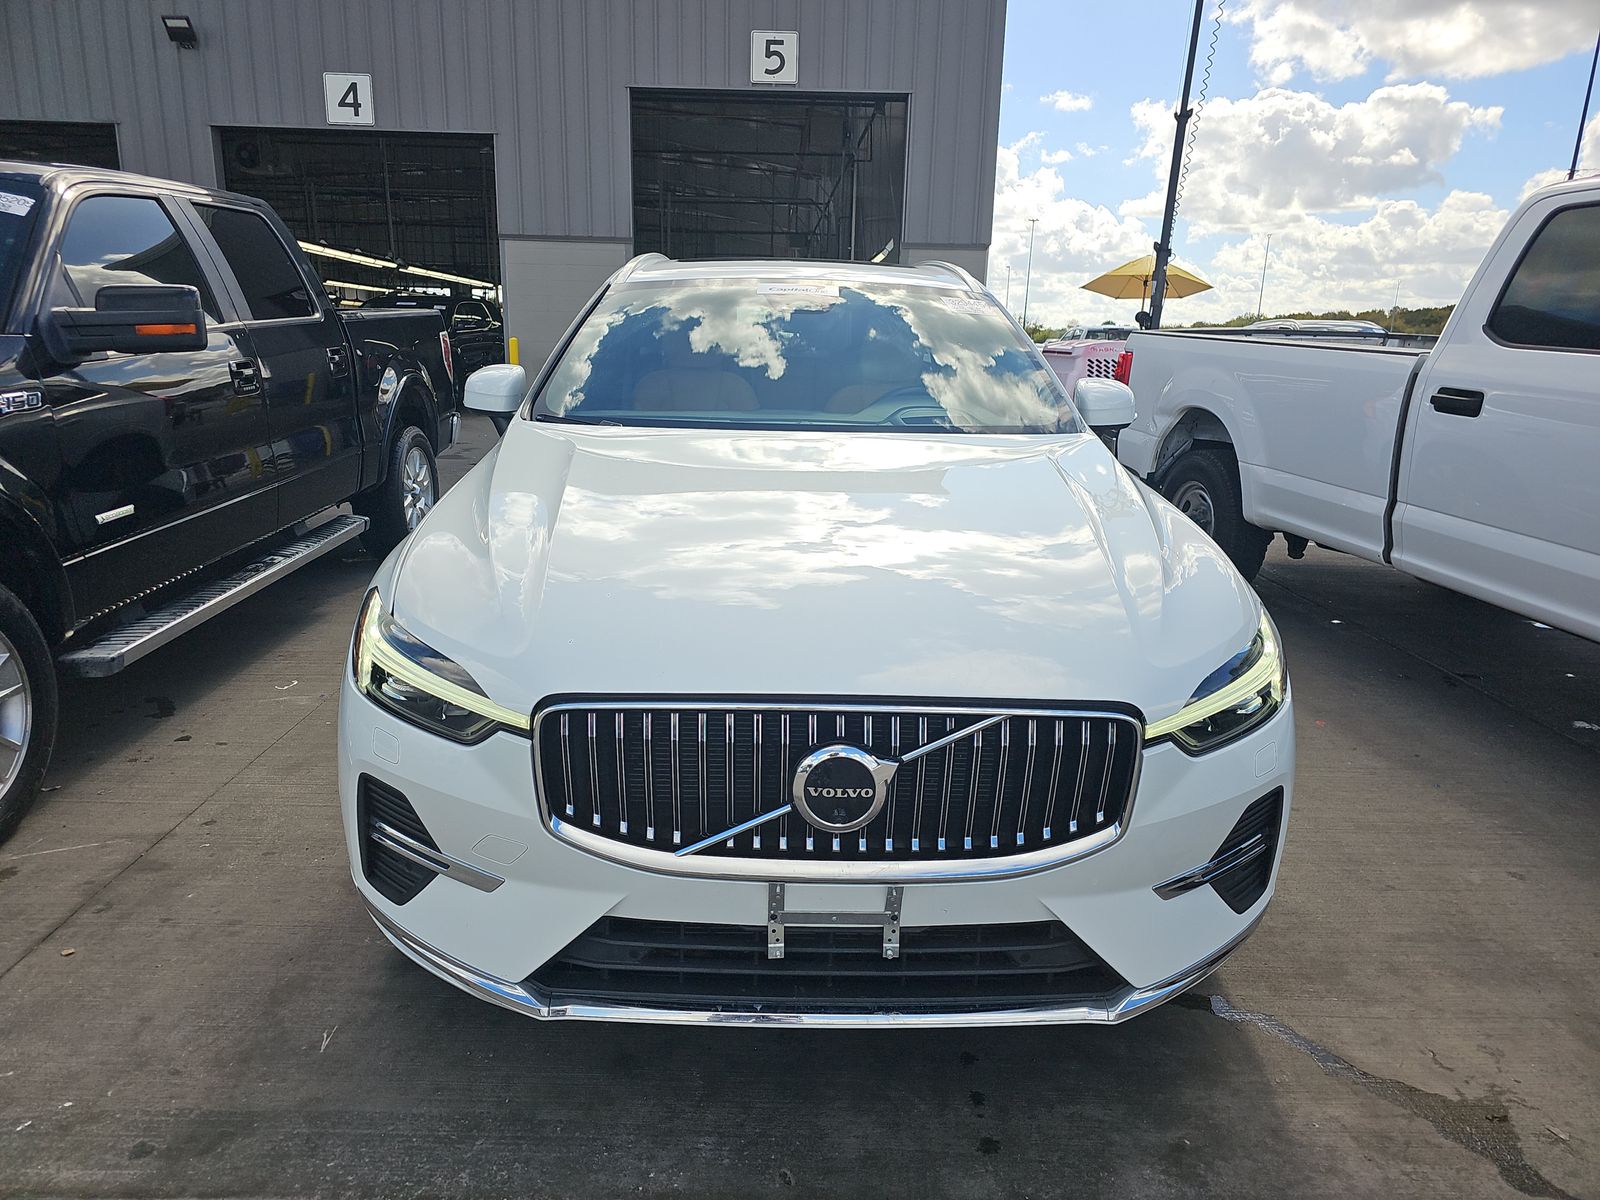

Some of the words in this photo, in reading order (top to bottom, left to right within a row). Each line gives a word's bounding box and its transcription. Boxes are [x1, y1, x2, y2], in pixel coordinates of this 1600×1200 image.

[764, 39, 785, 75] 5
[338, 82, 362, 117] 4
[806, 786, 874, 798] VOLVO
